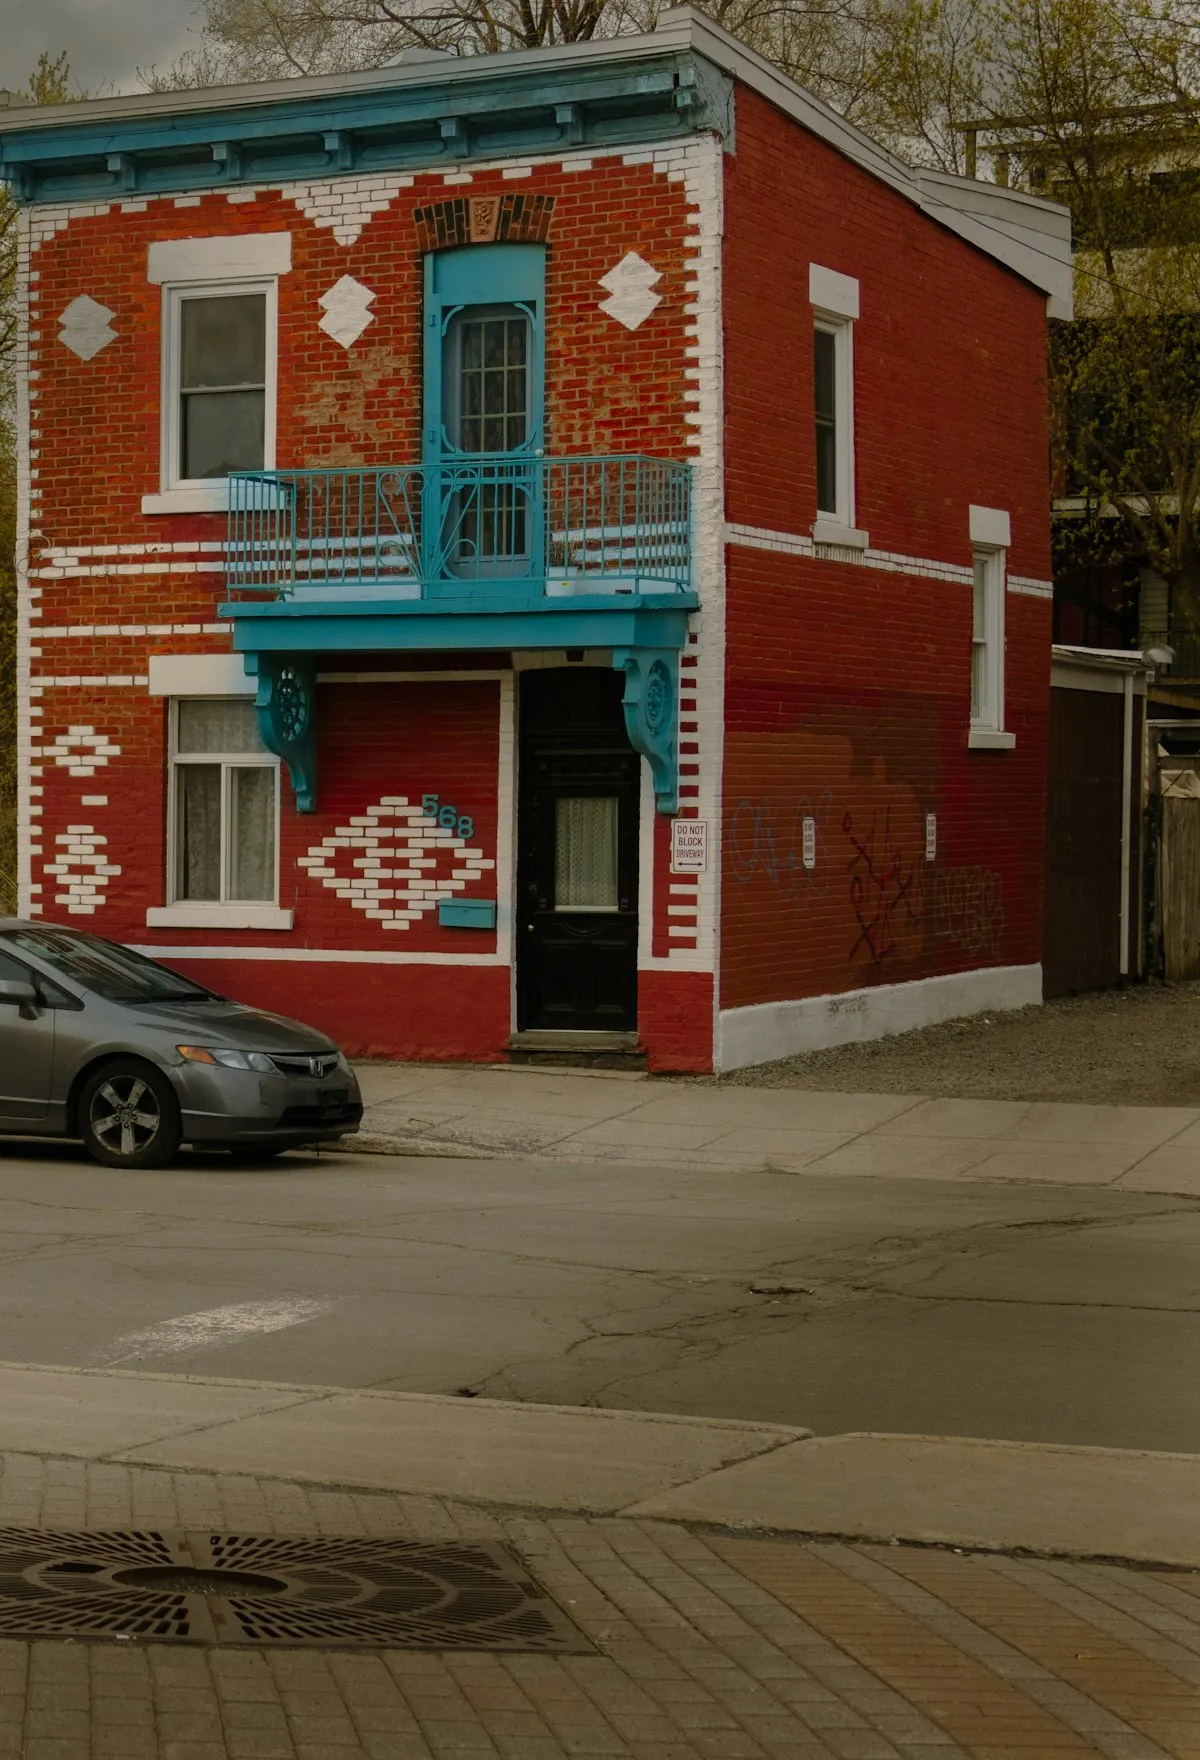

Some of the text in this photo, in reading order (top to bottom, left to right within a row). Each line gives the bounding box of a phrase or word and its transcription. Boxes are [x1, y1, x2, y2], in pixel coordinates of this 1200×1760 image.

[421, 793, 475, 839] 568
[677, 825, 705, 835] DO NOT
[678, 837, 703, 846] BLOCK
[676, 849, 704, 858] DRIVEWAY
